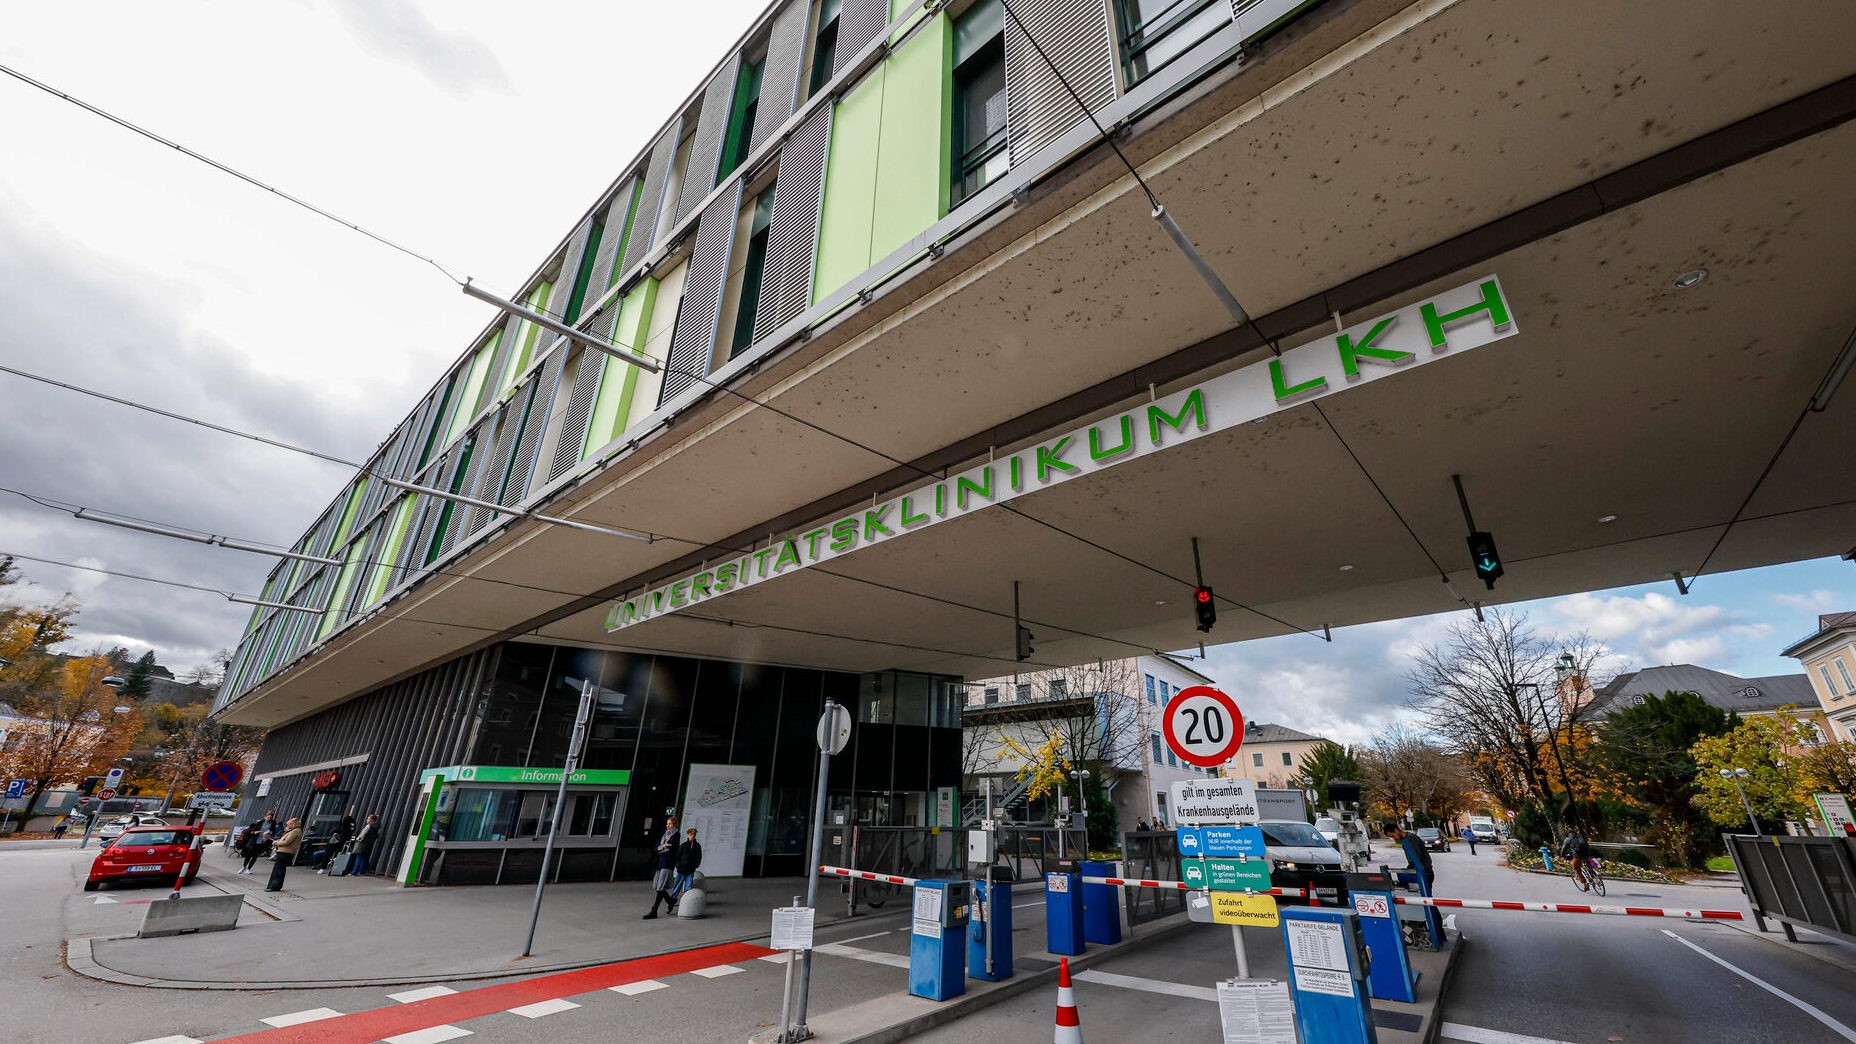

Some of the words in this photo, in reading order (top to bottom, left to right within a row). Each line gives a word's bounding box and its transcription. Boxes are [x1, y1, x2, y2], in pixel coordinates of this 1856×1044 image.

[604, 388, 1208, 630] UNIVERSITÄTSKLINIKUM
[1268, 278, 1512, 406] LKH
[1180, 705, 1224, 745] 20
[521, 769, 587, 781] Informaion
[8, 781, 20, 792] P
[99, 791, 115, 799] STOP
[1182, 786, 1194, 800] gilt
[1195, 786, 1205, 797] im
[1206, 786, 1243, 800] gesamten
[1177, 804, 1255, 819] Krankenhausgelände
[1211, 863, 1235, 871] Halten
[1218, 898, 1243, 907] Zufahrt
[1219, 909, 1276, 920] videoüberwacht
